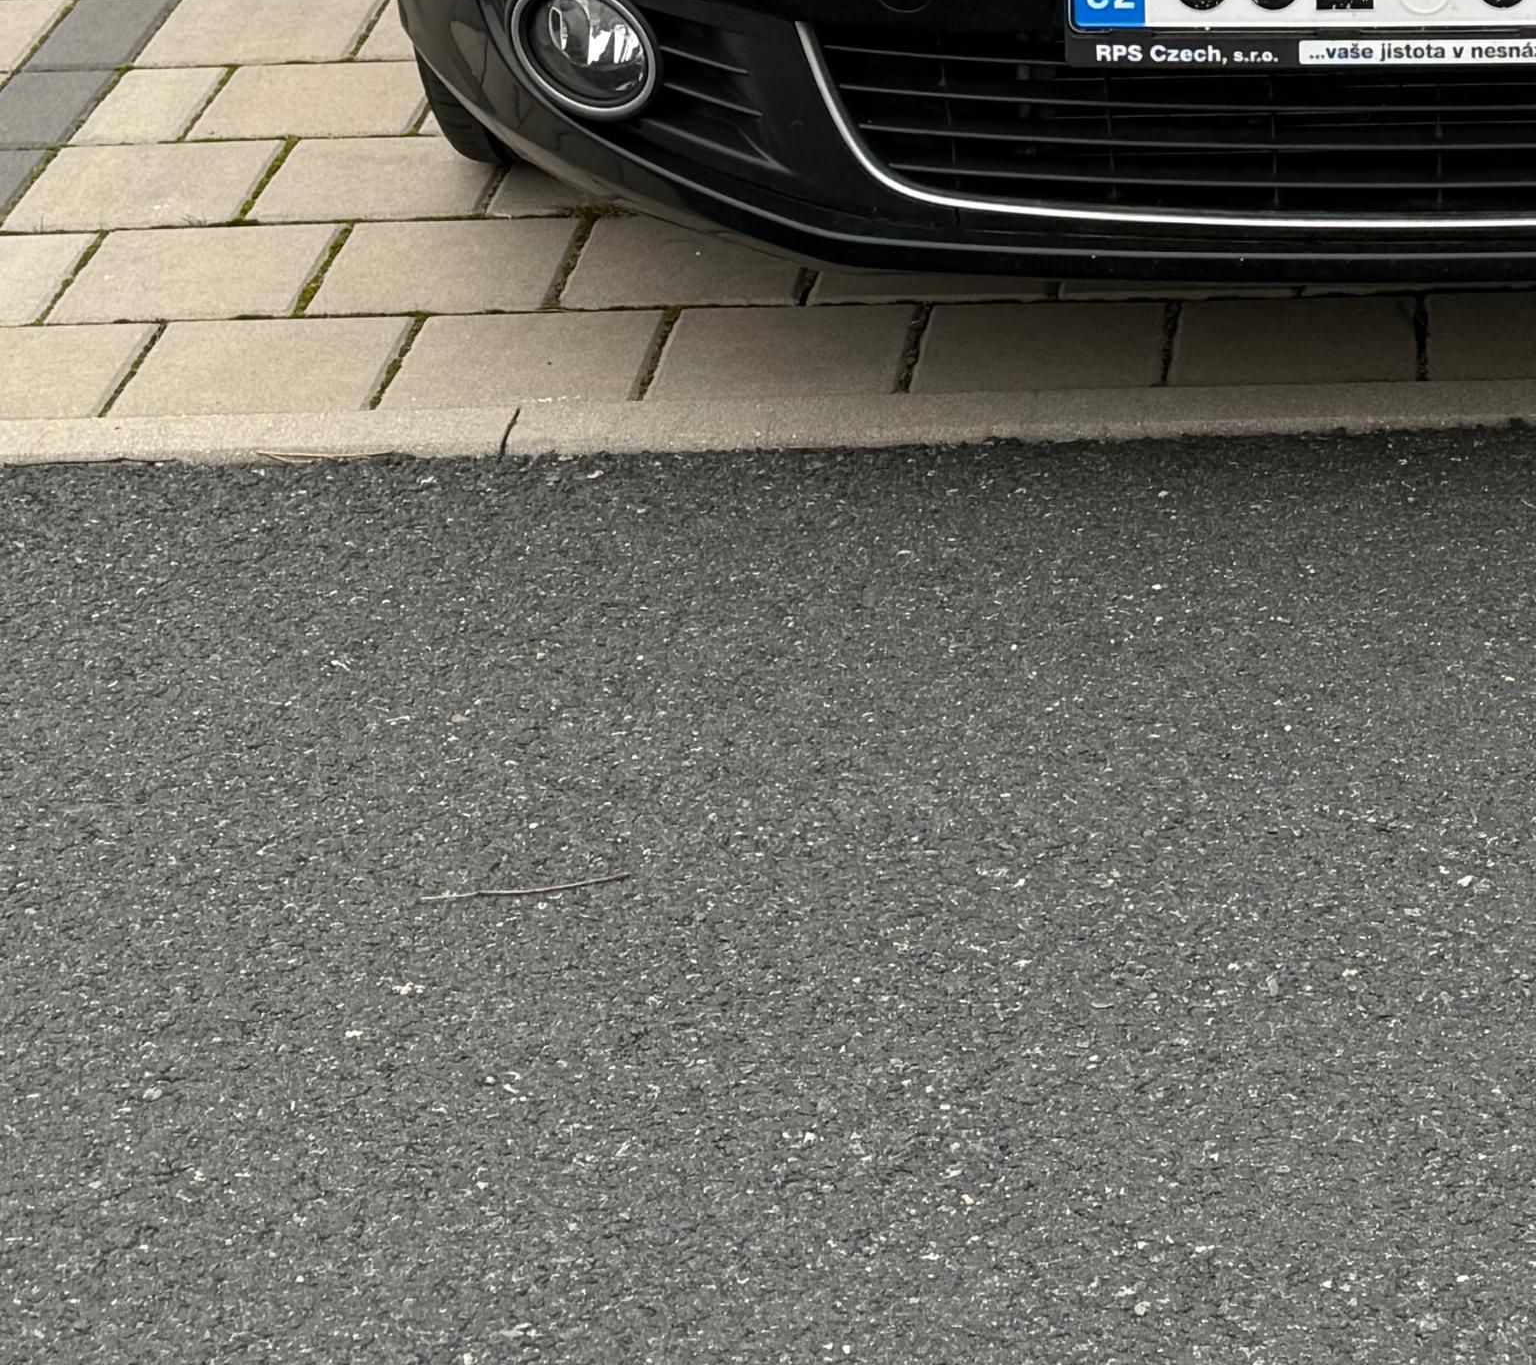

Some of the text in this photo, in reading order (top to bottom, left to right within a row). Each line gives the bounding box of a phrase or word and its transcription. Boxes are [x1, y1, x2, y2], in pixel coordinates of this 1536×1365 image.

[1095, 44, 1279, 66] RPS Czech, s.r.o.
[1309, 42, 1374, 59] ...vaše
[1379, 42, 1446, 62] jistota
[1453, 45, 1464, 59] v
